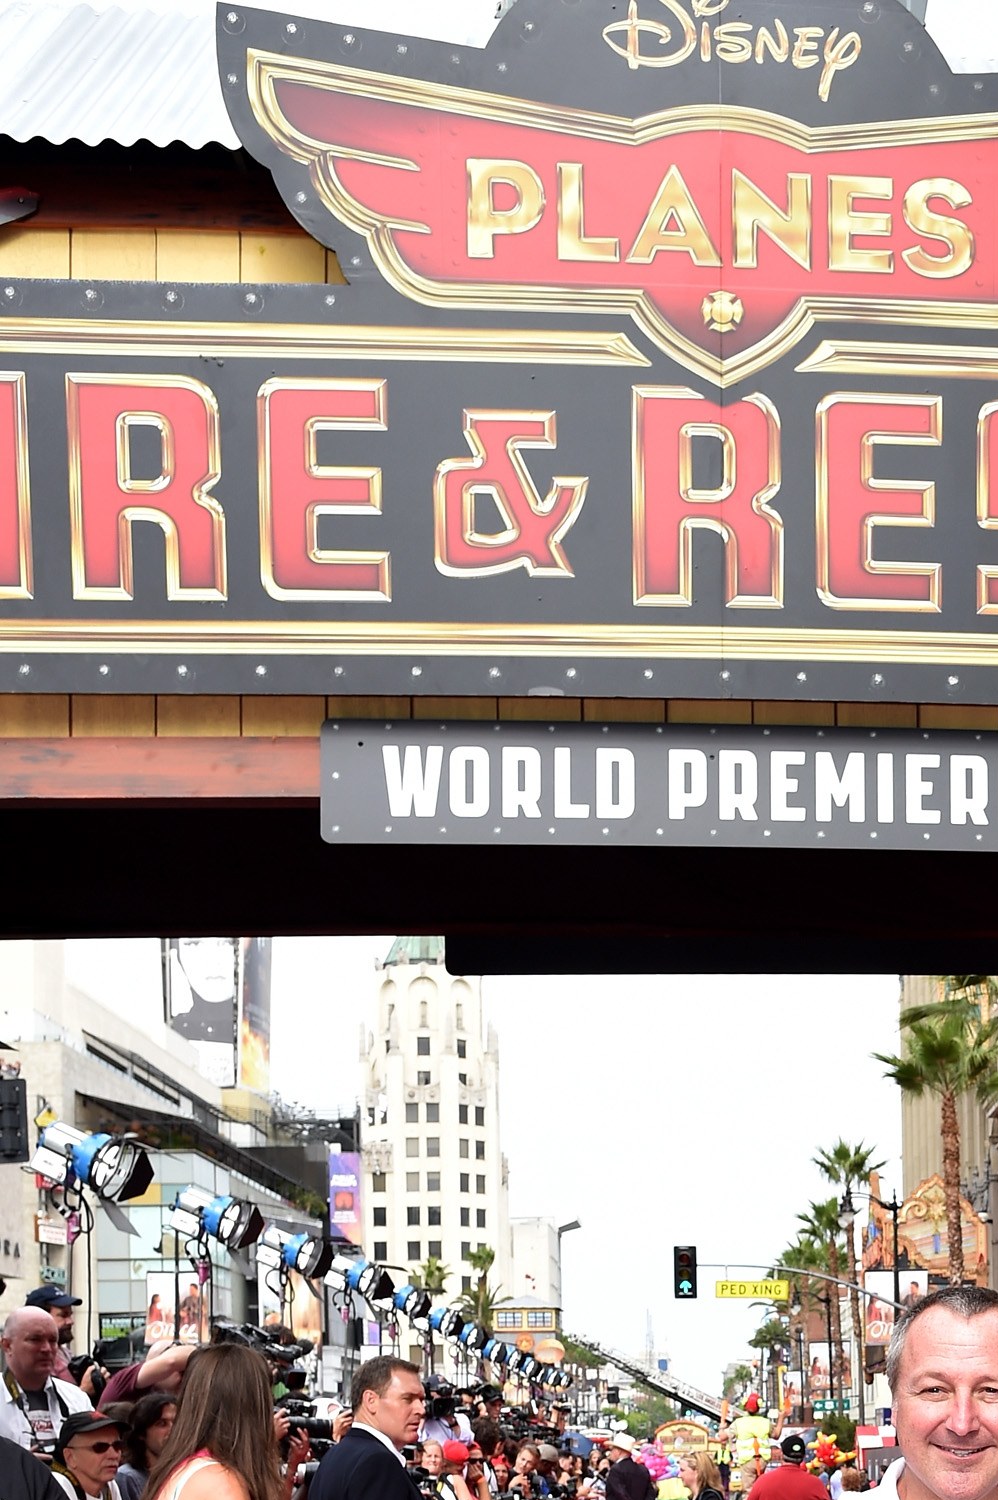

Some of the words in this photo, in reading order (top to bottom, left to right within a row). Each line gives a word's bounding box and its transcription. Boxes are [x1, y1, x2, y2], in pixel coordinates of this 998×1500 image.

[464, 158, 976, 280] PLANES
[432, 409, 589, 578] &
[381, 744, 636, 821] WORLD
[0, 1238, 20, 1258] RA
[721, 1284, 746, 1295] PED
[752, 1285, 782, 1296] XING
